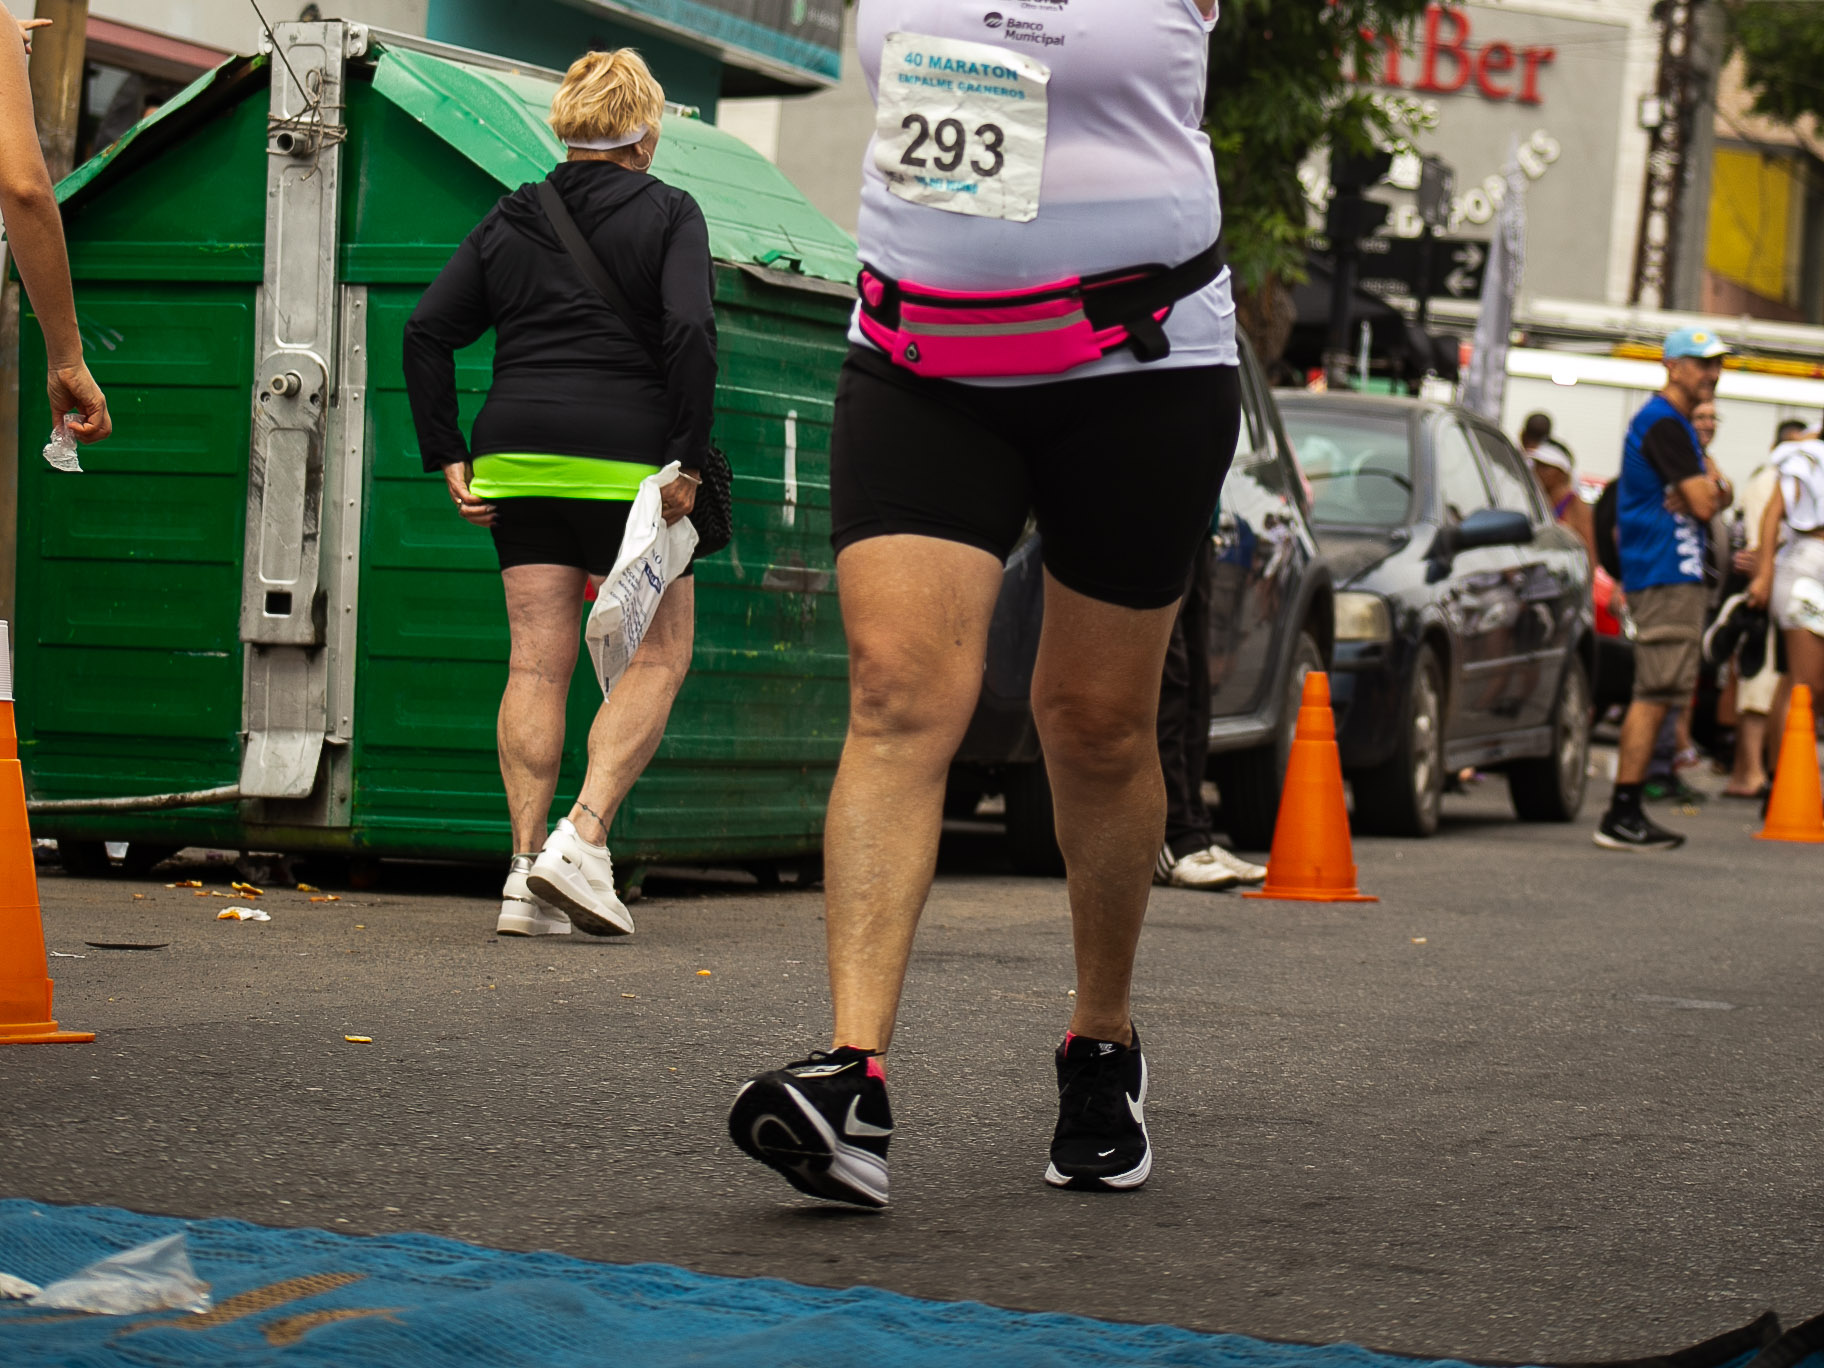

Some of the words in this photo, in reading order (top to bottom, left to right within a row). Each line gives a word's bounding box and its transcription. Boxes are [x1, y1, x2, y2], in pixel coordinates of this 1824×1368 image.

[1006, 18, 1044, 31] Banco
[1004, 30, 1065, 47] Municipal
[904, 52, 923, 67] 40
[929, 56, 1018, 82] MARATON
[898, 73, 953, 90] EMPALME
[958, 82, 1026, 100] GRANEROS
[901, 113, 1004, 177] 293
